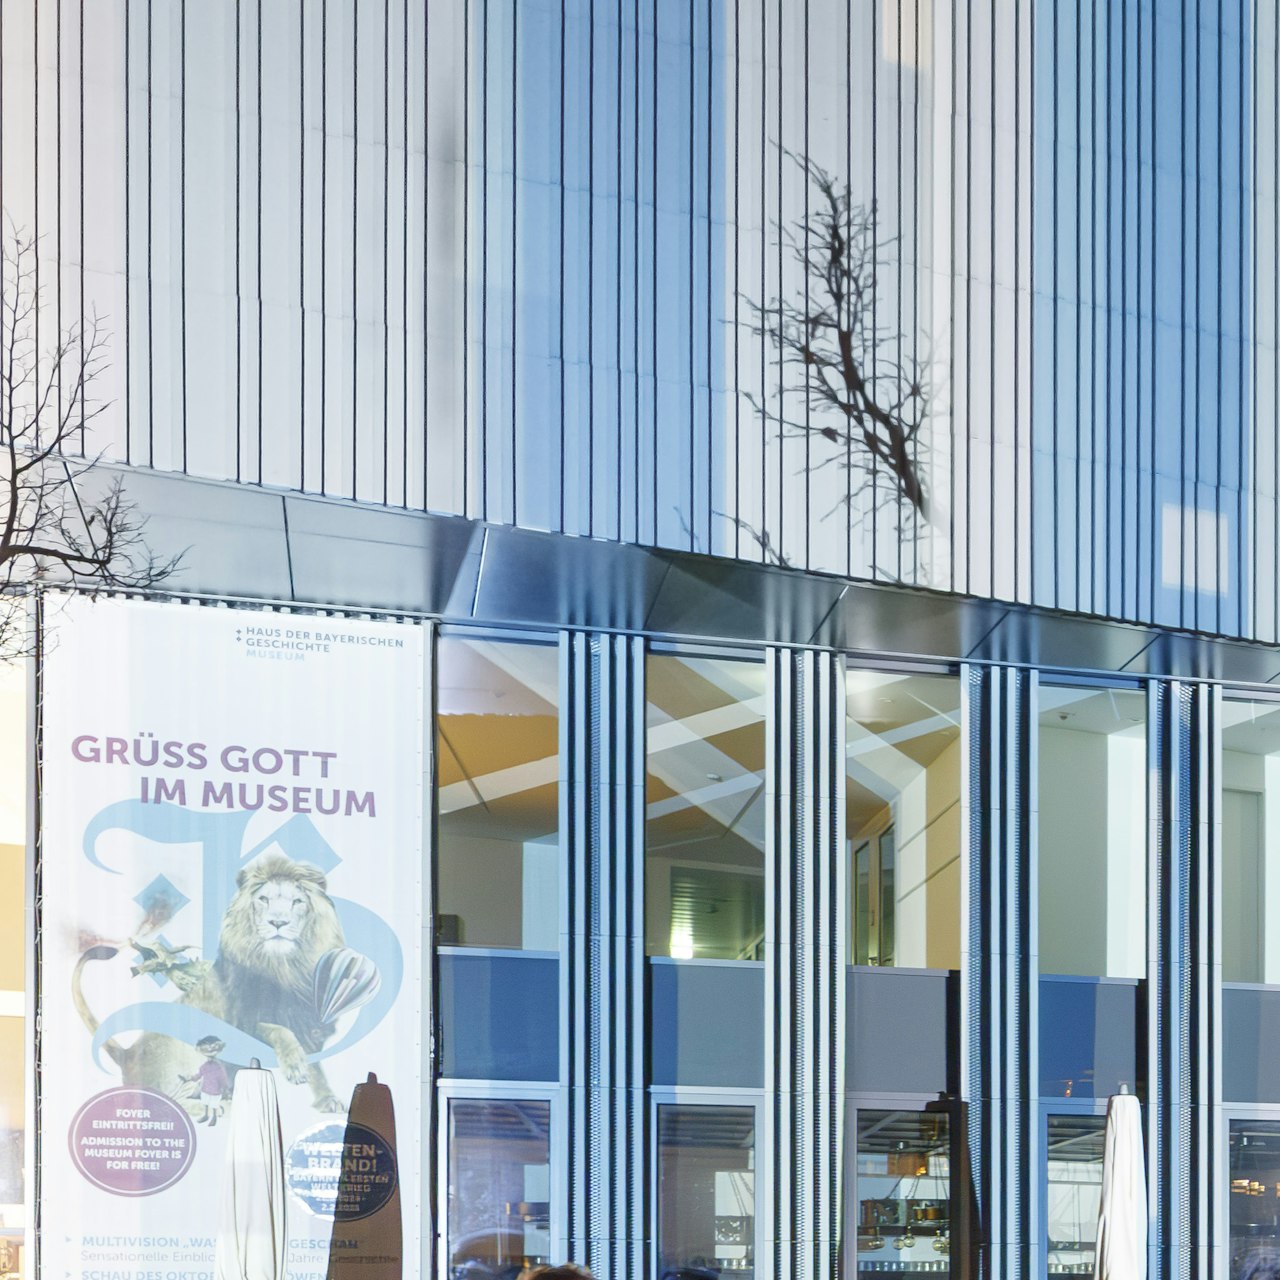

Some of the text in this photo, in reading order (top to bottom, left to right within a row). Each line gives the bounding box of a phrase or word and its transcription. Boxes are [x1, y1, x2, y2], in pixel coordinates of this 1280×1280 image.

[246, 627, 404, 648] HAUS DER BAYERISCHEN
[246, 638, 331, 653] GESCHICHTE
[246, 649, 305, 661] MUSEUM
[71, 731, 337, 778] GRÜSS GOTT
[140, 776, 377, 818] IM MUSEUM
[116, 1109, 151, 1119] FOYER
[92, 1120, 174, 1131] EINTRITTSFREI!
[81, 1137, 185, 1148] ADMISSION TO THE
[84, 1148, 182, 1159] MUSEUM FOYER IS
[106, 1161, 160, 1171] FOR FREE!
[307, 1157, 377, 1172] BRAND!
[82, 1236, 179, 1248] MULTIVISION
[183, 1238, 217, 1249] „WA
[80, 1250, 168, 1263] Sensationelle
[172, 1251, 215, 1263] Einblic
[288, 1253, 324, 1264] Jahre
